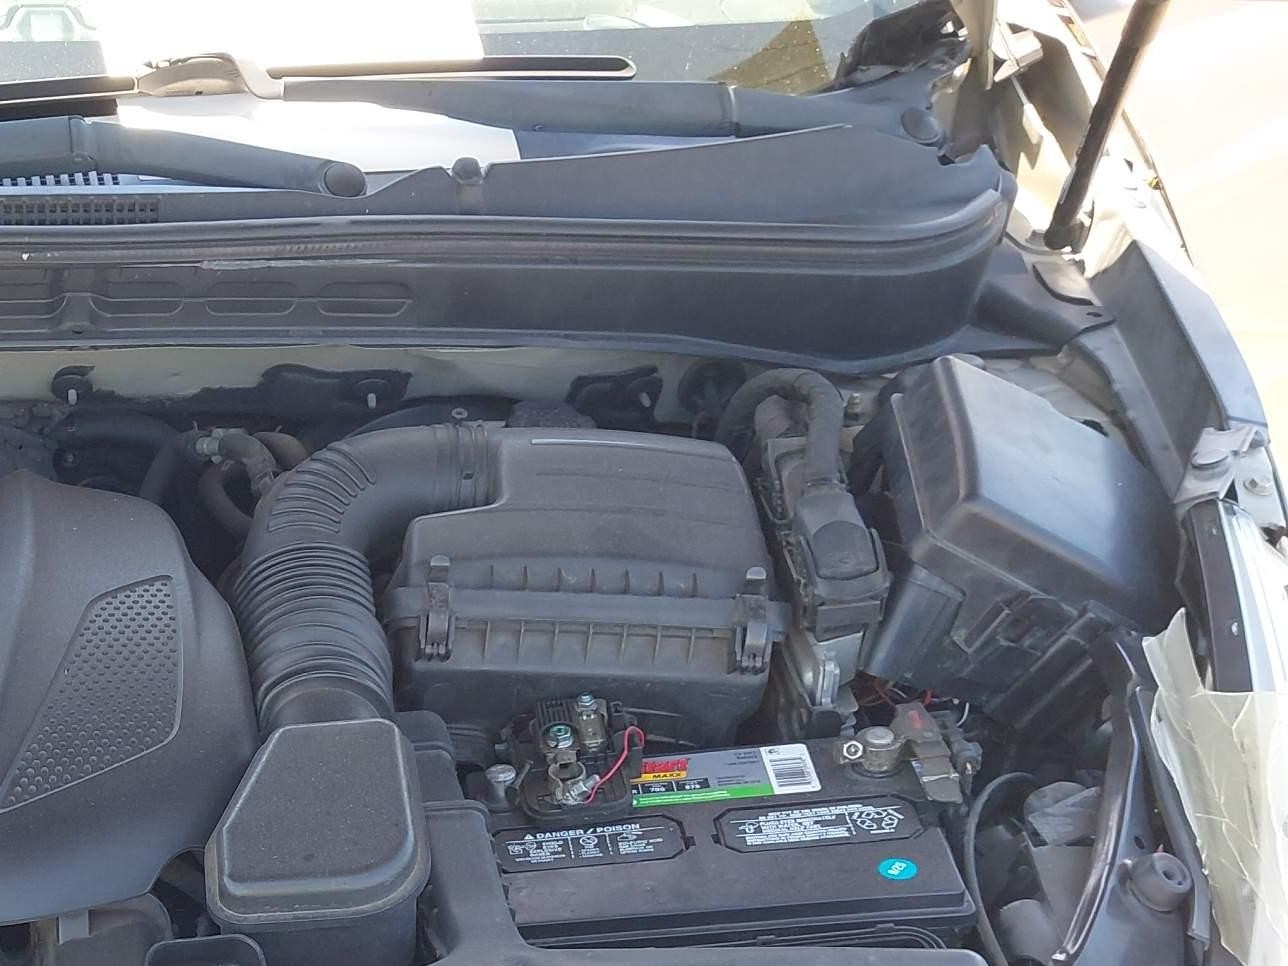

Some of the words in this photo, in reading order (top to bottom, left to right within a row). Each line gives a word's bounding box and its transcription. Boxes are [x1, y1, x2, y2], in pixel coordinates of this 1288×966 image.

[652, 772, 681, 780] MAXX
[536, 828, 585, 839] DANGER
[596, 823, 640, 834] POISON
